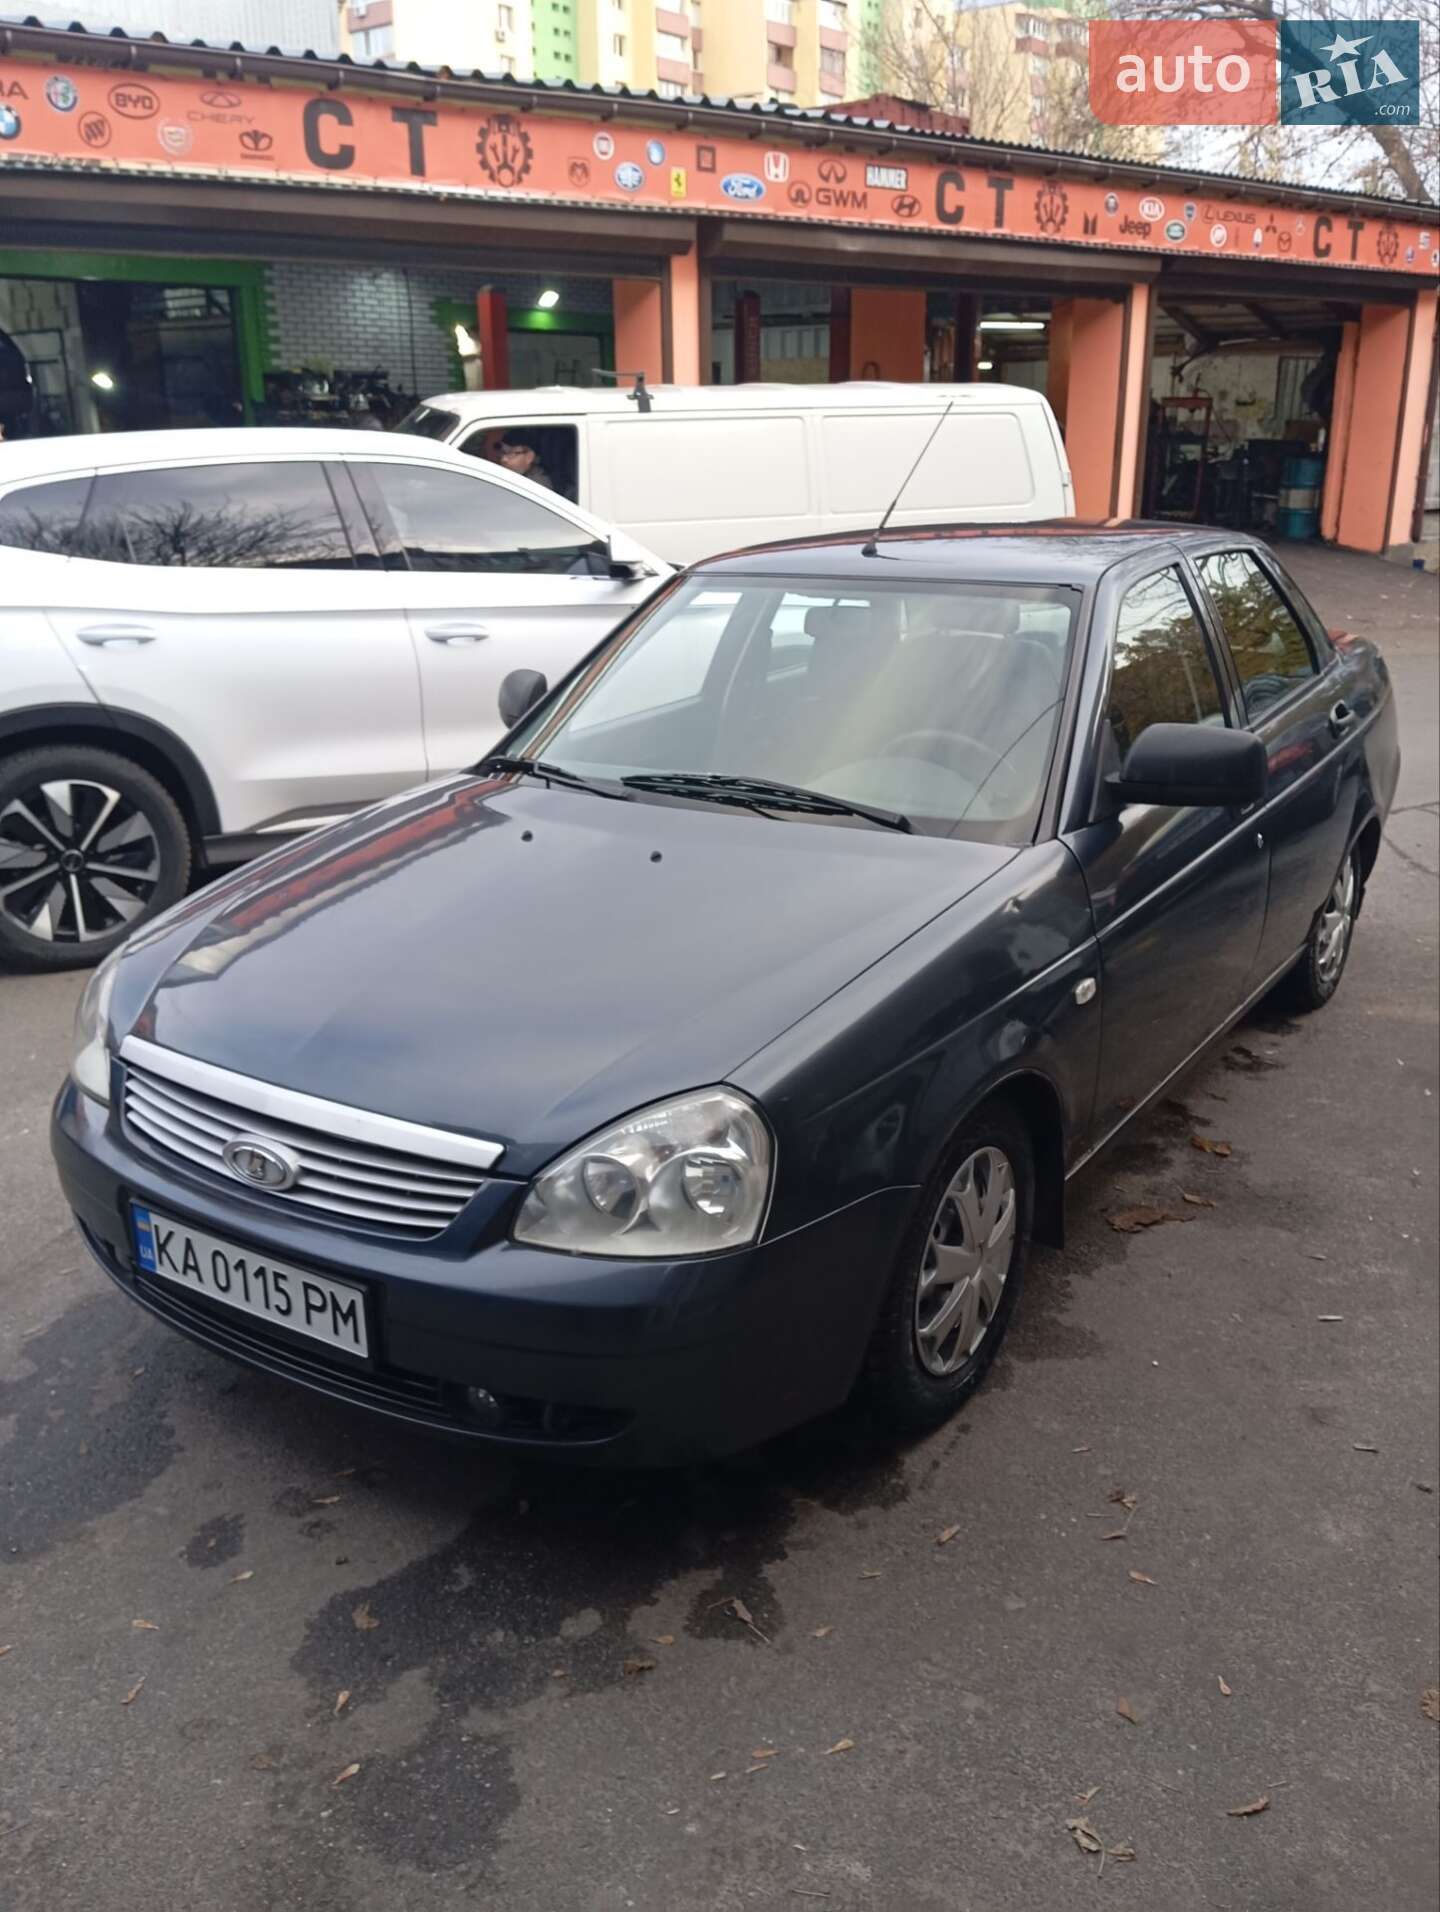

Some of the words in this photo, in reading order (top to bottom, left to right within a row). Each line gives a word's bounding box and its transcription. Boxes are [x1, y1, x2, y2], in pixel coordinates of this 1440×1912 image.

[815, 187, 868, 210] GWM
[1119, 214, 1152, 239] Jeep
[154, 1224, 203, 1284] KA
[211, 1249, 292, 1316] 0115
[302, 1281, 360, 1345] PM
